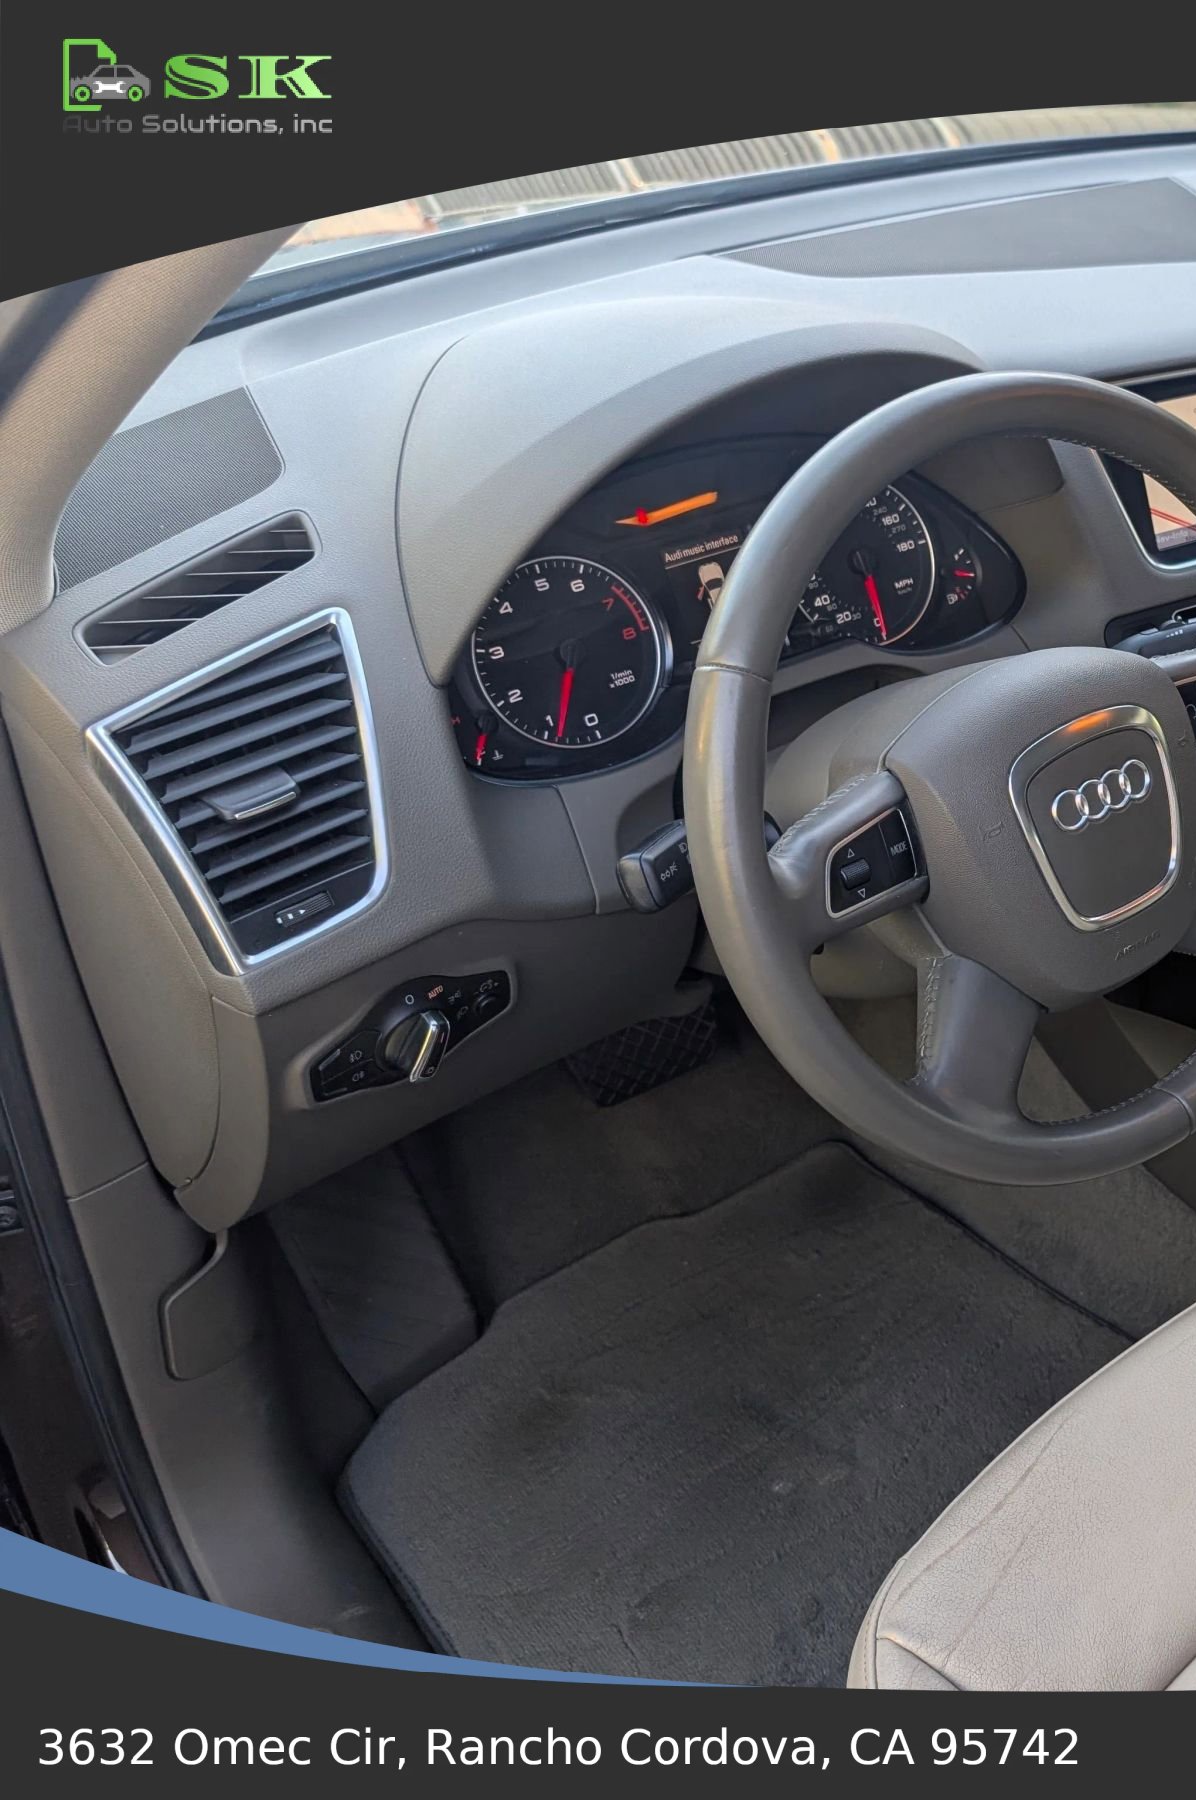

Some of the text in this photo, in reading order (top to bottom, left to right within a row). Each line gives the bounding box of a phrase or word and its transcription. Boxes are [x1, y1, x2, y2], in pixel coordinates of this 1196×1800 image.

[882, 514, 900, 526] 160
[892, 524, 906, 534] 270
[665, 534, 739, 563] Audi music interface
[896, 540, 915, 553] 180
[534, 578, 550, 592] 5
[570, 579, 585, 593] 6
[894, 577, 914, 589] MPH
[602, 597, 615, 612] 7
[814, 594, 831, 607] 40
[499, 601, 513, 615] 4
[836, 611, 852, 624] 20
[622, 627, 637, 641] 8
[489, 646, 505, 660] 3
[611, 669, 633, 680] 1/min
[609, 675, 636, 689] x1000
[508, 689, 523, 703] 2
[545, 715, 554, 727] 1
[584, 713, 599, 727] 0
[428, 984, 444, 999] AUTO
